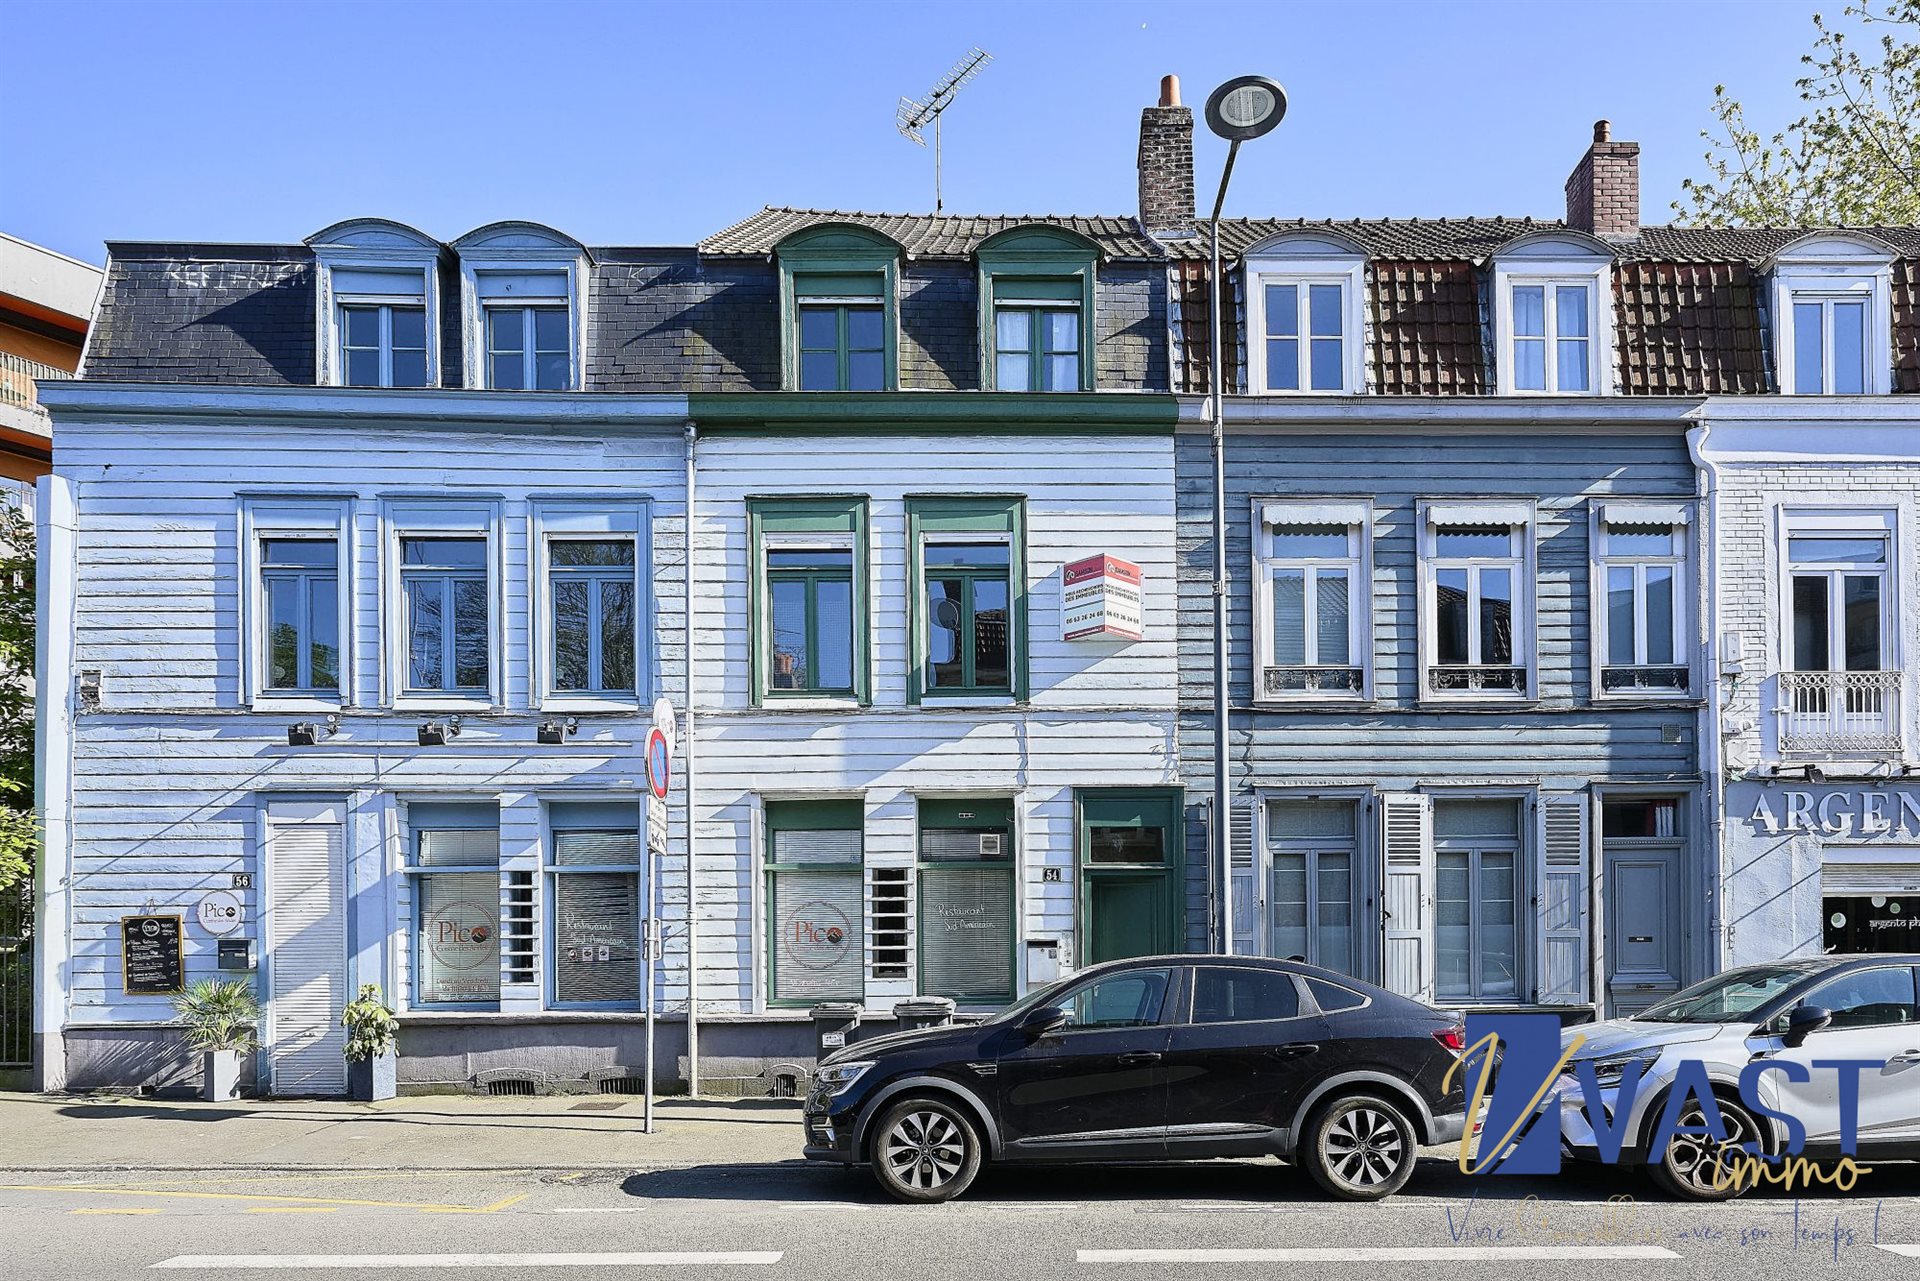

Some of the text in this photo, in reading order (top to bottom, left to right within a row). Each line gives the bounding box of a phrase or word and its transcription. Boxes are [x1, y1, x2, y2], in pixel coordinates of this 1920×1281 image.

[1075, 587, 1104, 600] IMMEUBLES
[235, 876, 248, 886] 56
[1046, 869, 1058, 880] 54
[204, 902, 236, 918] Pico
[935, 903, 985, 917] Restaurant
[438, 920, 488, 944] Pico
[795, 921, 843, 944] Pico
